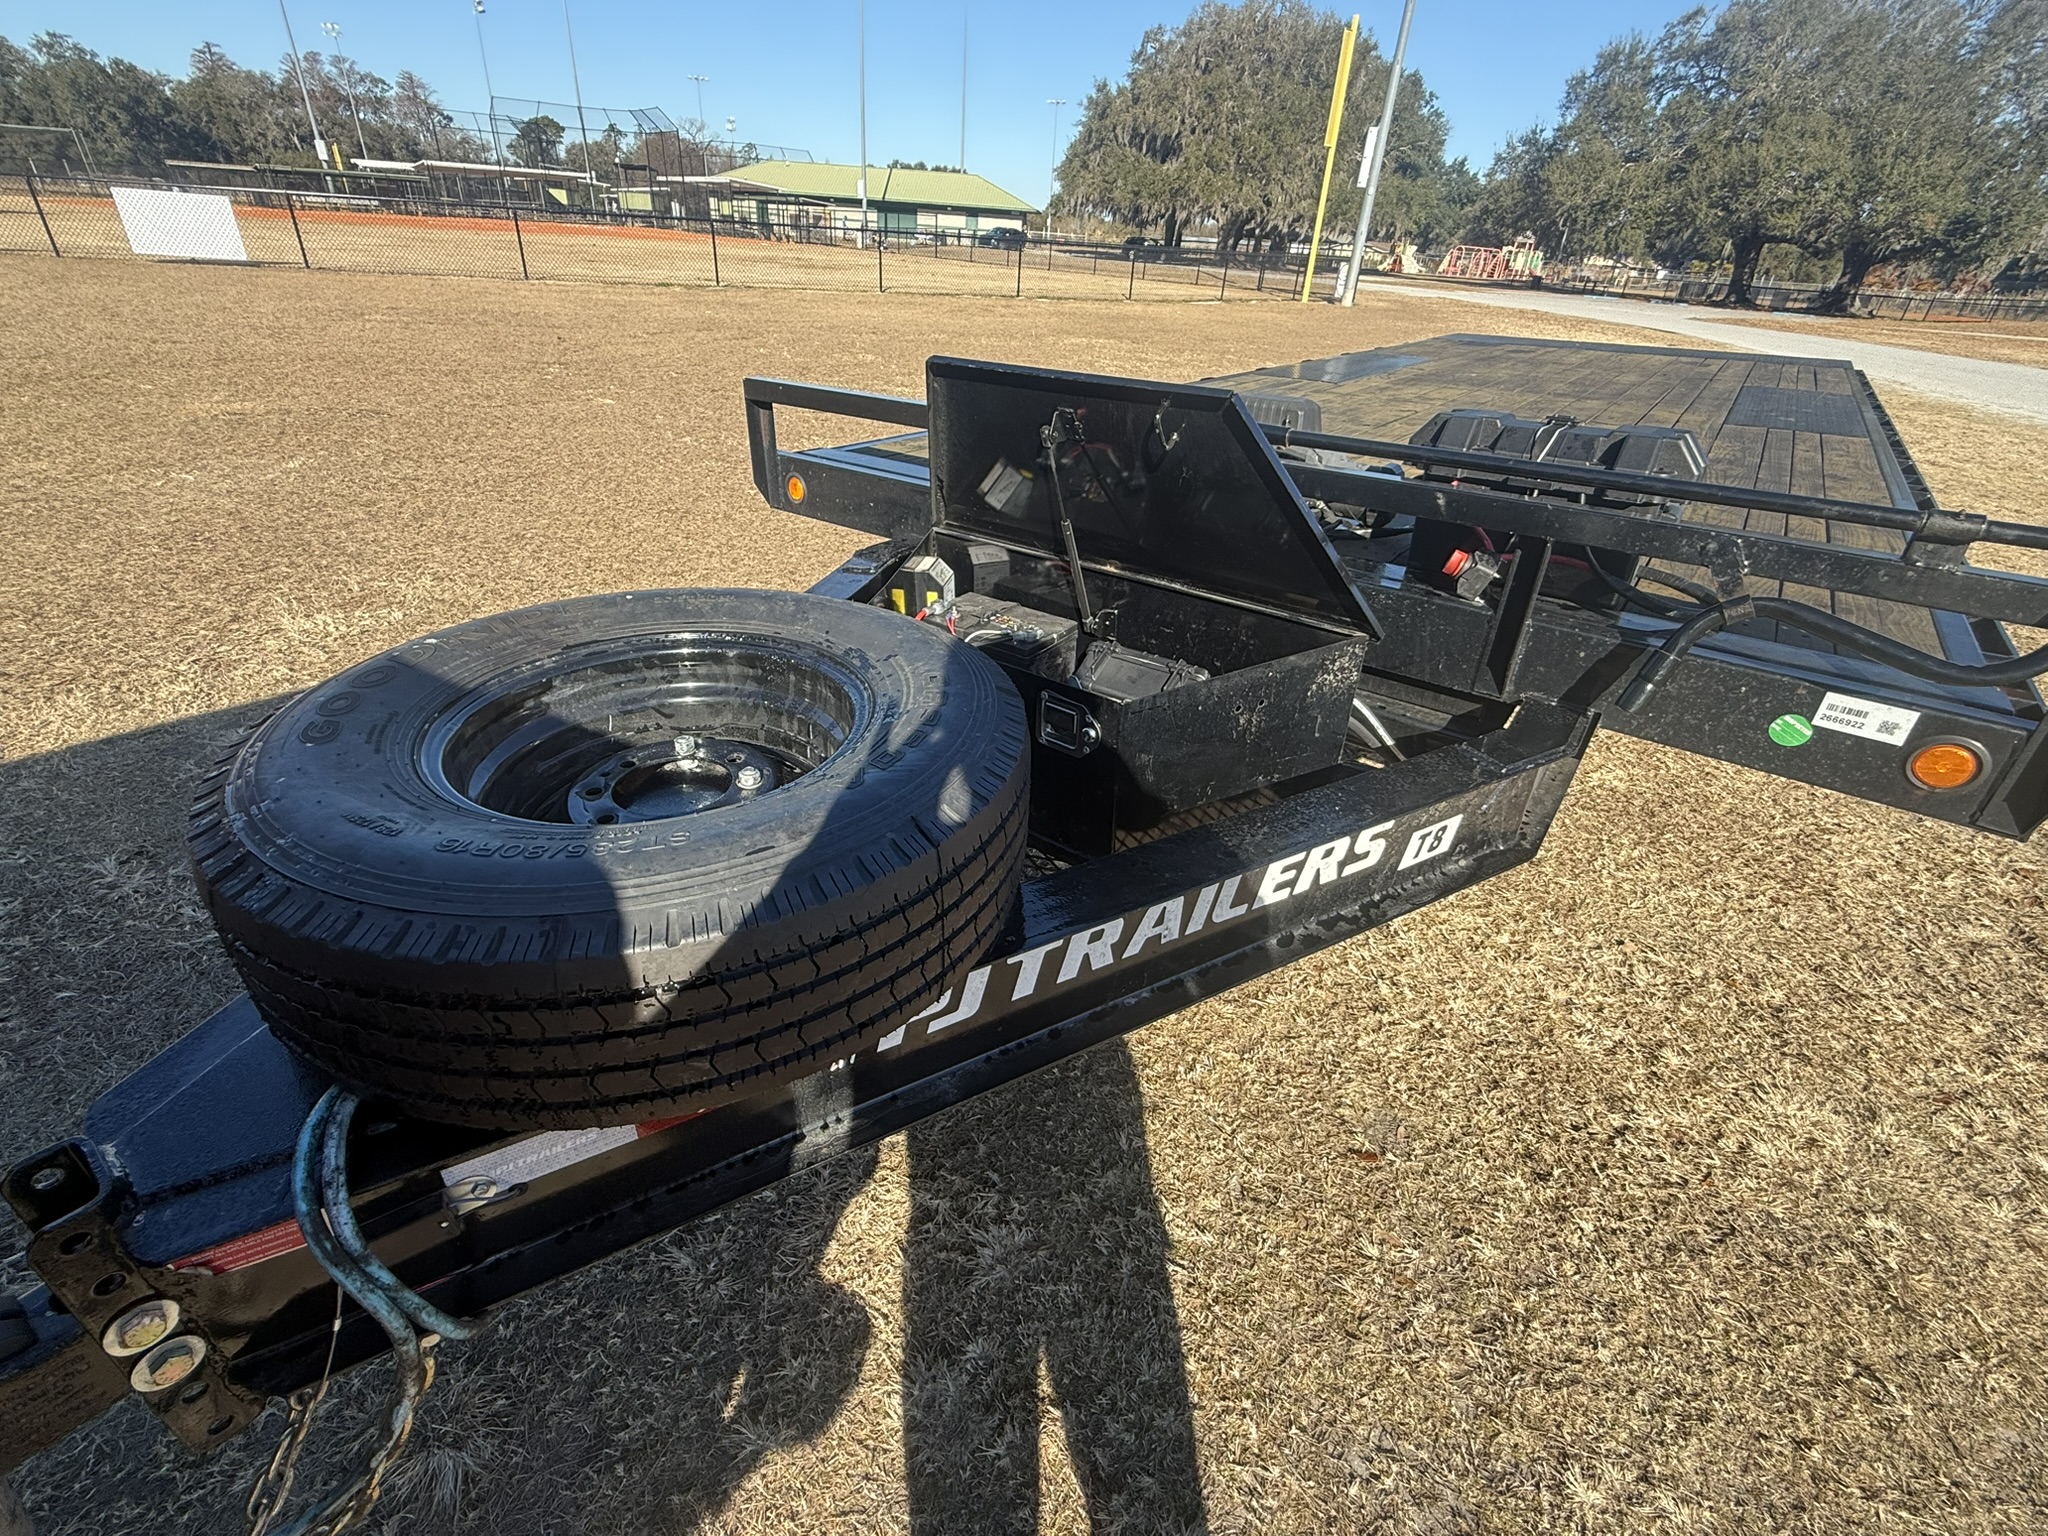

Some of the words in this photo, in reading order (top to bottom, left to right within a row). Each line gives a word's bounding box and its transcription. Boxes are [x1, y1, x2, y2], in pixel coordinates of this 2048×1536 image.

[1819, 713, 1865, 730] 2666922
[1006, 819, 1396, 1002] TRAILERS
[516, 1131, 598, 1167] TRAILERS
